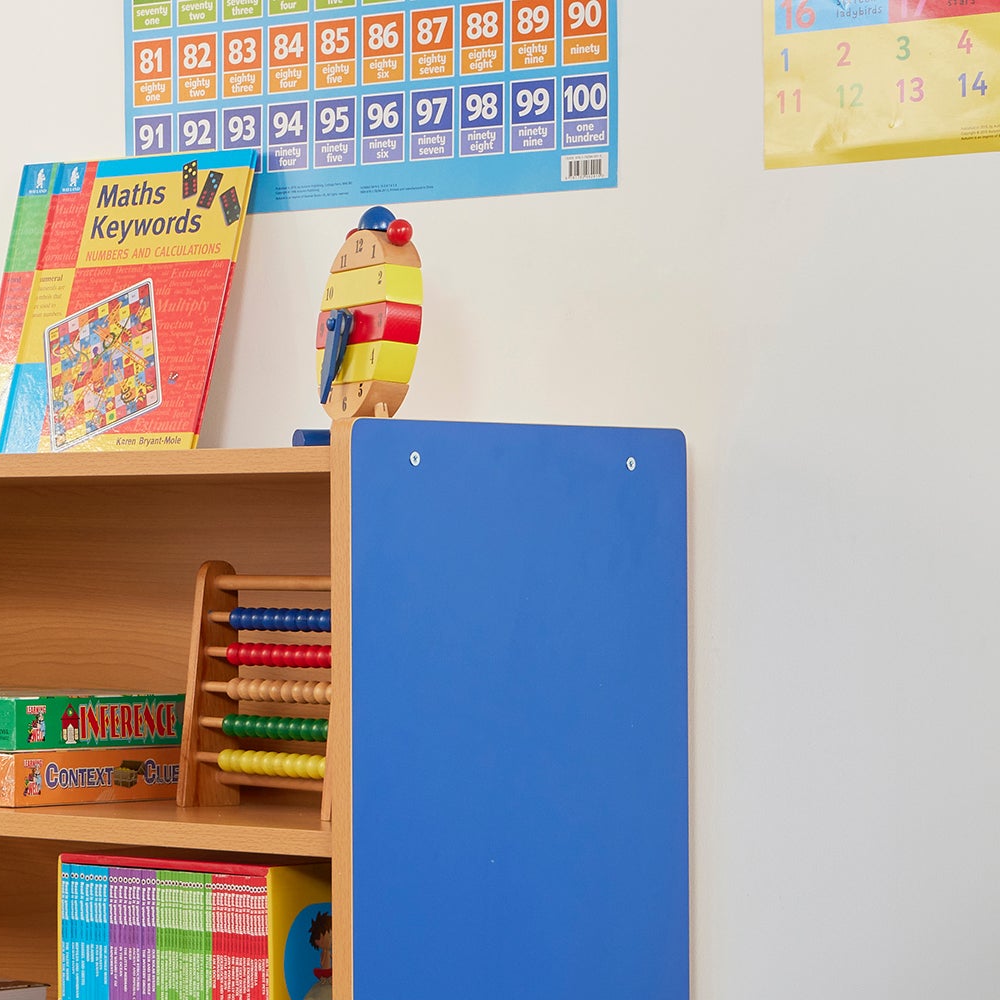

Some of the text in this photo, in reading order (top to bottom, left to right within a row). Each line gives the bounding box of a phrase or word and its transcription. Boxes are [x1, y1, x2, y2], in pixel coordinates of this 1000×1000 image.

[136, 6, 168, 17] seventy
[181, 1, 213, 12] seventy
[231, 7, 254, 16] three
[280, 1, 296, 11] four
[836, 6, 882, 19] ladybirds
[189, 12, 206, 21] two
[517, 5, 550, 35] 89
[567, 0, 602, 30] 90
[781, 0, 816, 30] 16
[144, 18, 160, 26] one
[466, 11, 499, 40] 88
[368, 21, 399, 50] 86
[417, 16, 448, 45] 87
[273, 32, 304, 60] 84
[320, 26, 350, 55] 85
[957, 30, 973, 54] 4
[228, 37, 257, 65] 83
[468, 48, 497, 61] eighty
[518, 43, 548, 56] eighty
[570, 43, 600, 55] ninety
[836, 42, 852, 67] 2
[896, 36, 911, 61] 3
[139, 47, 163, 74] 81
[183, 42, 212, 70] 82
[418, 53, 447, 66] eighty
[524, 54, 544, 65] nine
[780, 48, 789, 72] 1
[322, 64, 350, 76] eighty
[369, 58, 397, 71] eighty
[419, 65, 445, 75] seven
[469, 59, 493, 71] eight
[229, 73, 256, 85] eighty
[275, 68, 302, 81] eighty
[326, 73, 343, 84] five
[377, 70, 389, 79] six
[139, 81, 166, 94] eighty
[184, 78, 211, 90] eighty
[231, 83, 254, 93] three
[279, 79, 298, 89] four
[896, 77, 925, 103] 13
[957, 71, 988, 97] 14
[145, 93, 161, 102] one
[189, 88, 206, 98] two
[564, 82, 607, 113] 100
[836, 83, 864, 108] 12
[465, 92, 498, 122] 98
[516, 87, 550, 117] 99
[776, 89, 801, 114] 11
[367, 101, 399, 131] 96
[416, 97, 448, 126] 97
[273, 110, 303, 139] 94
[320, 106, 350, 135] 95
[183, 119, 211, 147] 92
[228, 114, 255, 143] 93
[518, 125, 548, 138] ninety
[576, 122, 594, 133] one
[139, 123, 164, 150] 91
[418, 134, 446, 147] ninety
[467, 130, 496, 143] ninety
[523, 136, 543, 147] nine
[565, 131, 605, 143] hundred
[321, 142, 348, 154] ninety
[369, 138, 397, 151] ninety
[419, 145, 445, 155] seven
[470, 140, 494, 153] eight
[274, 146, 301, 158] ninety
[326, 152, 343, 163] five
[376, 149, 389, 159] six
[279, 156, 297, 167] four
[96, 181, 166, 209] Maths
[90, 208, 202, 244] Keywords
[355, 238, 364, 253] 12
[371, 244, 376, 259] 1
[86, 247, 129, 262] NUMBERS
[131, 247, 151, 259] AND
[153, 243, 222, 258] CALCULATIONS
[340, 254, 347, 268] 11
[377, 270, 383, 285] 2
[326, 286, 334, 301] 10
[358, 383, 363, 397] 5
[342, 397, 347, 411] 6
[116, 437, 136, 446] Karen
[79, 702, 177, 739] INFERENCE
[143, 759, 179, 785] CLUE
